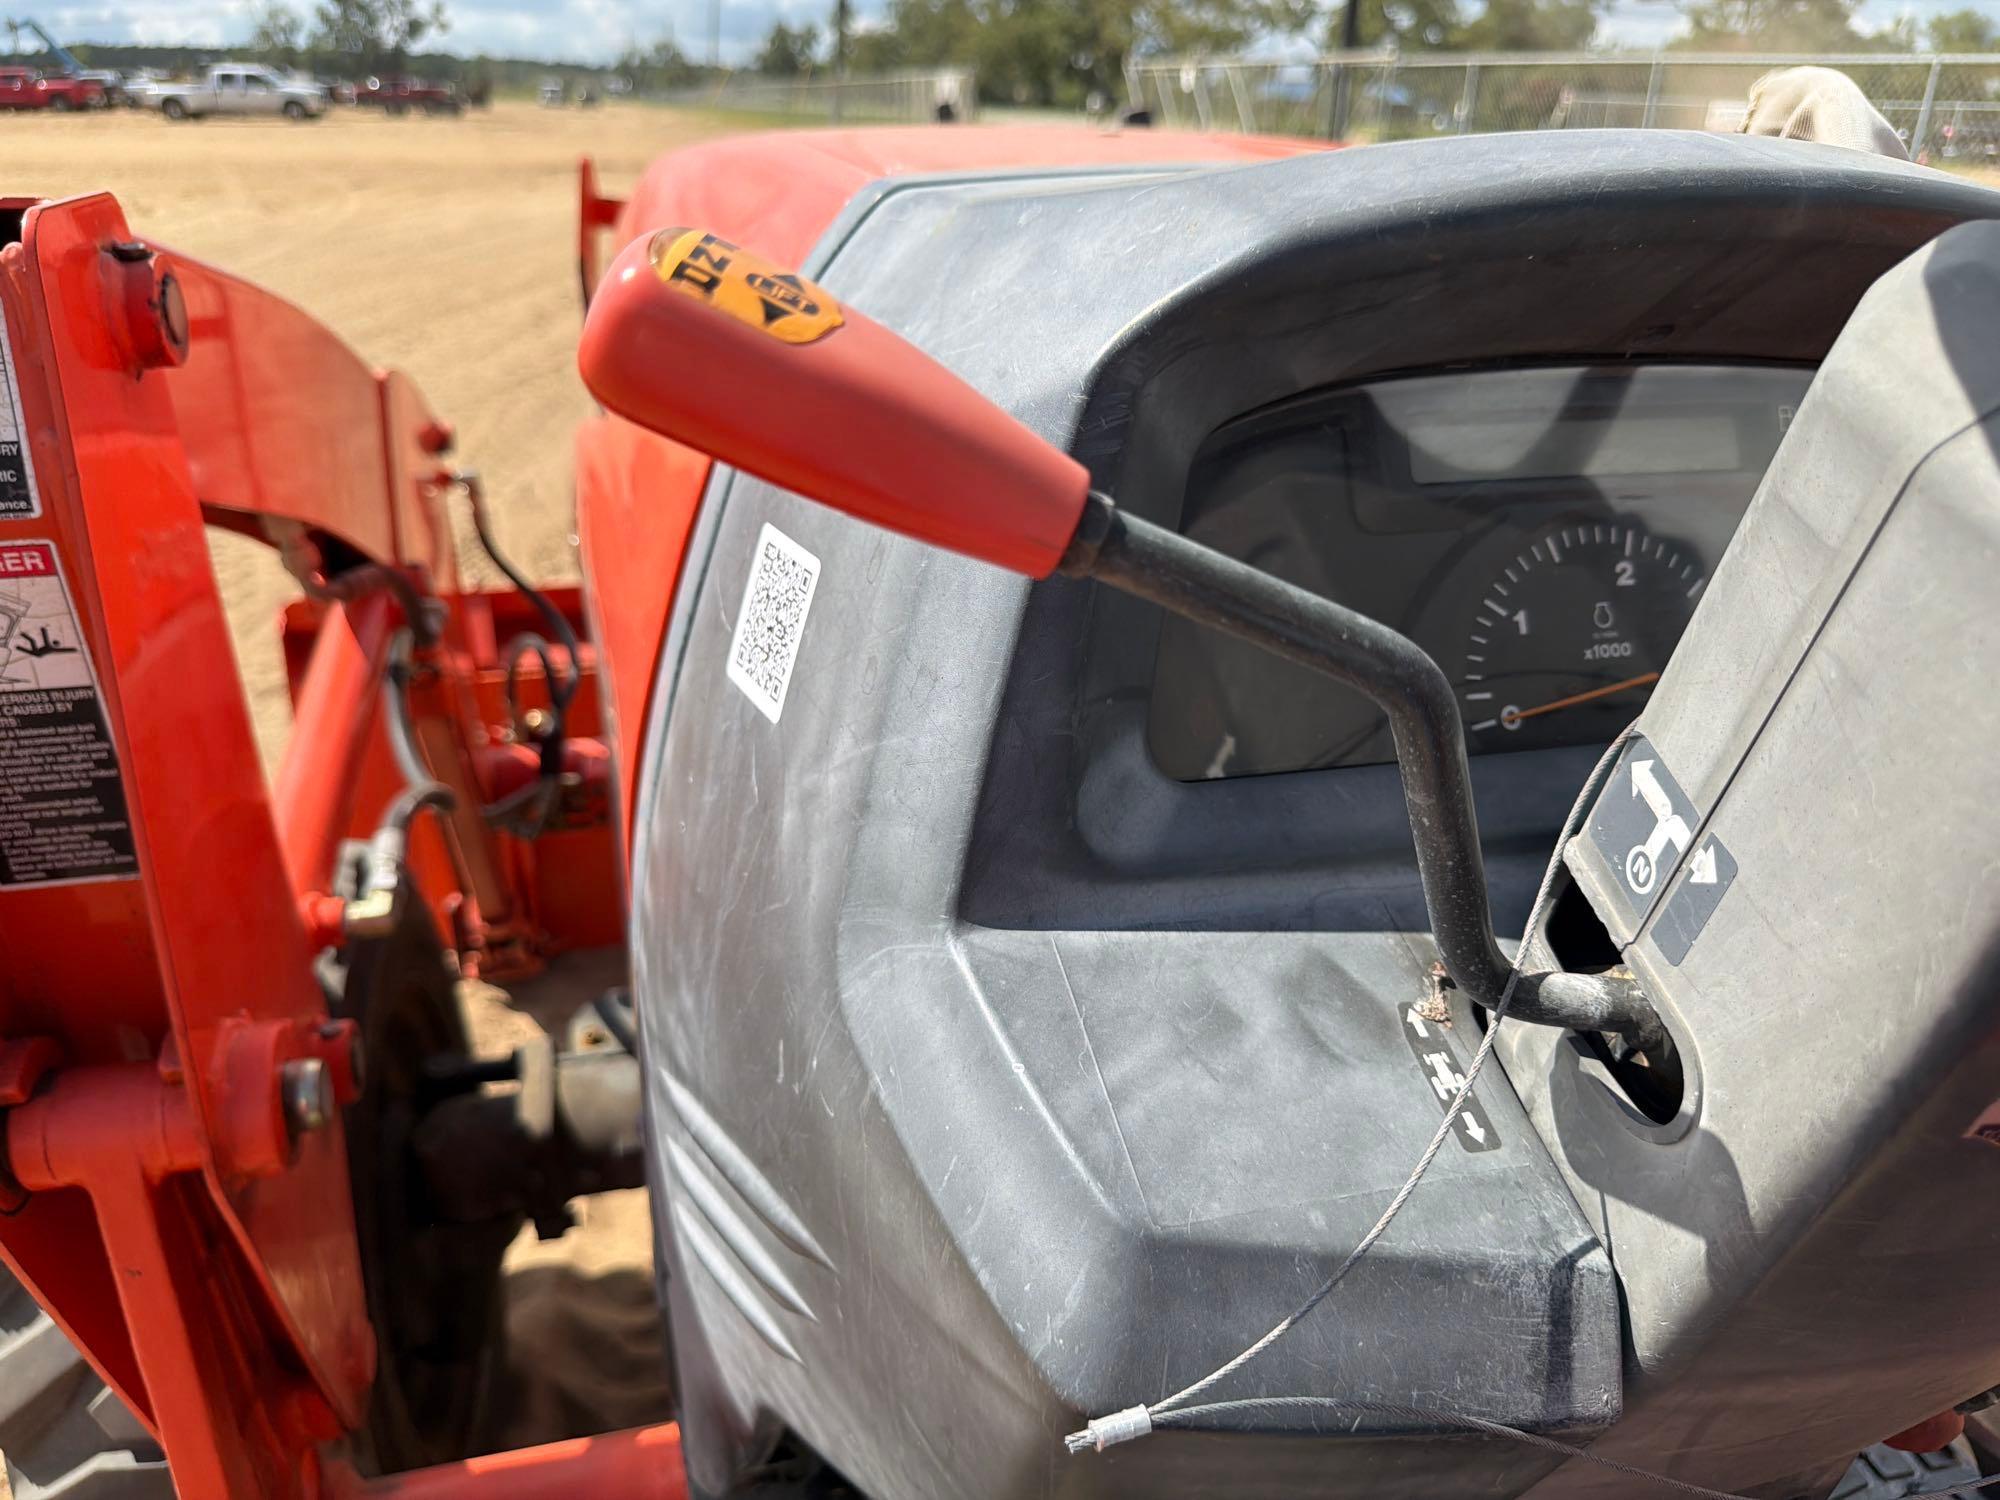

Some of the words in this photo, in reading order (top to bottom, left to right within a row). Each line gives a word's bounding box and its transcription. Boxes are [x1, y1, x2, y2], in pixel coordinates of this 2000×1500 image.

[0, 444, 18, 457] RY
[1614, 561, 1636, 587] 2
[1512, 609, 1529, 636] 1
[1583, 641, 1632, 661] x1000
[1501, 705, 1521, 731] 0
